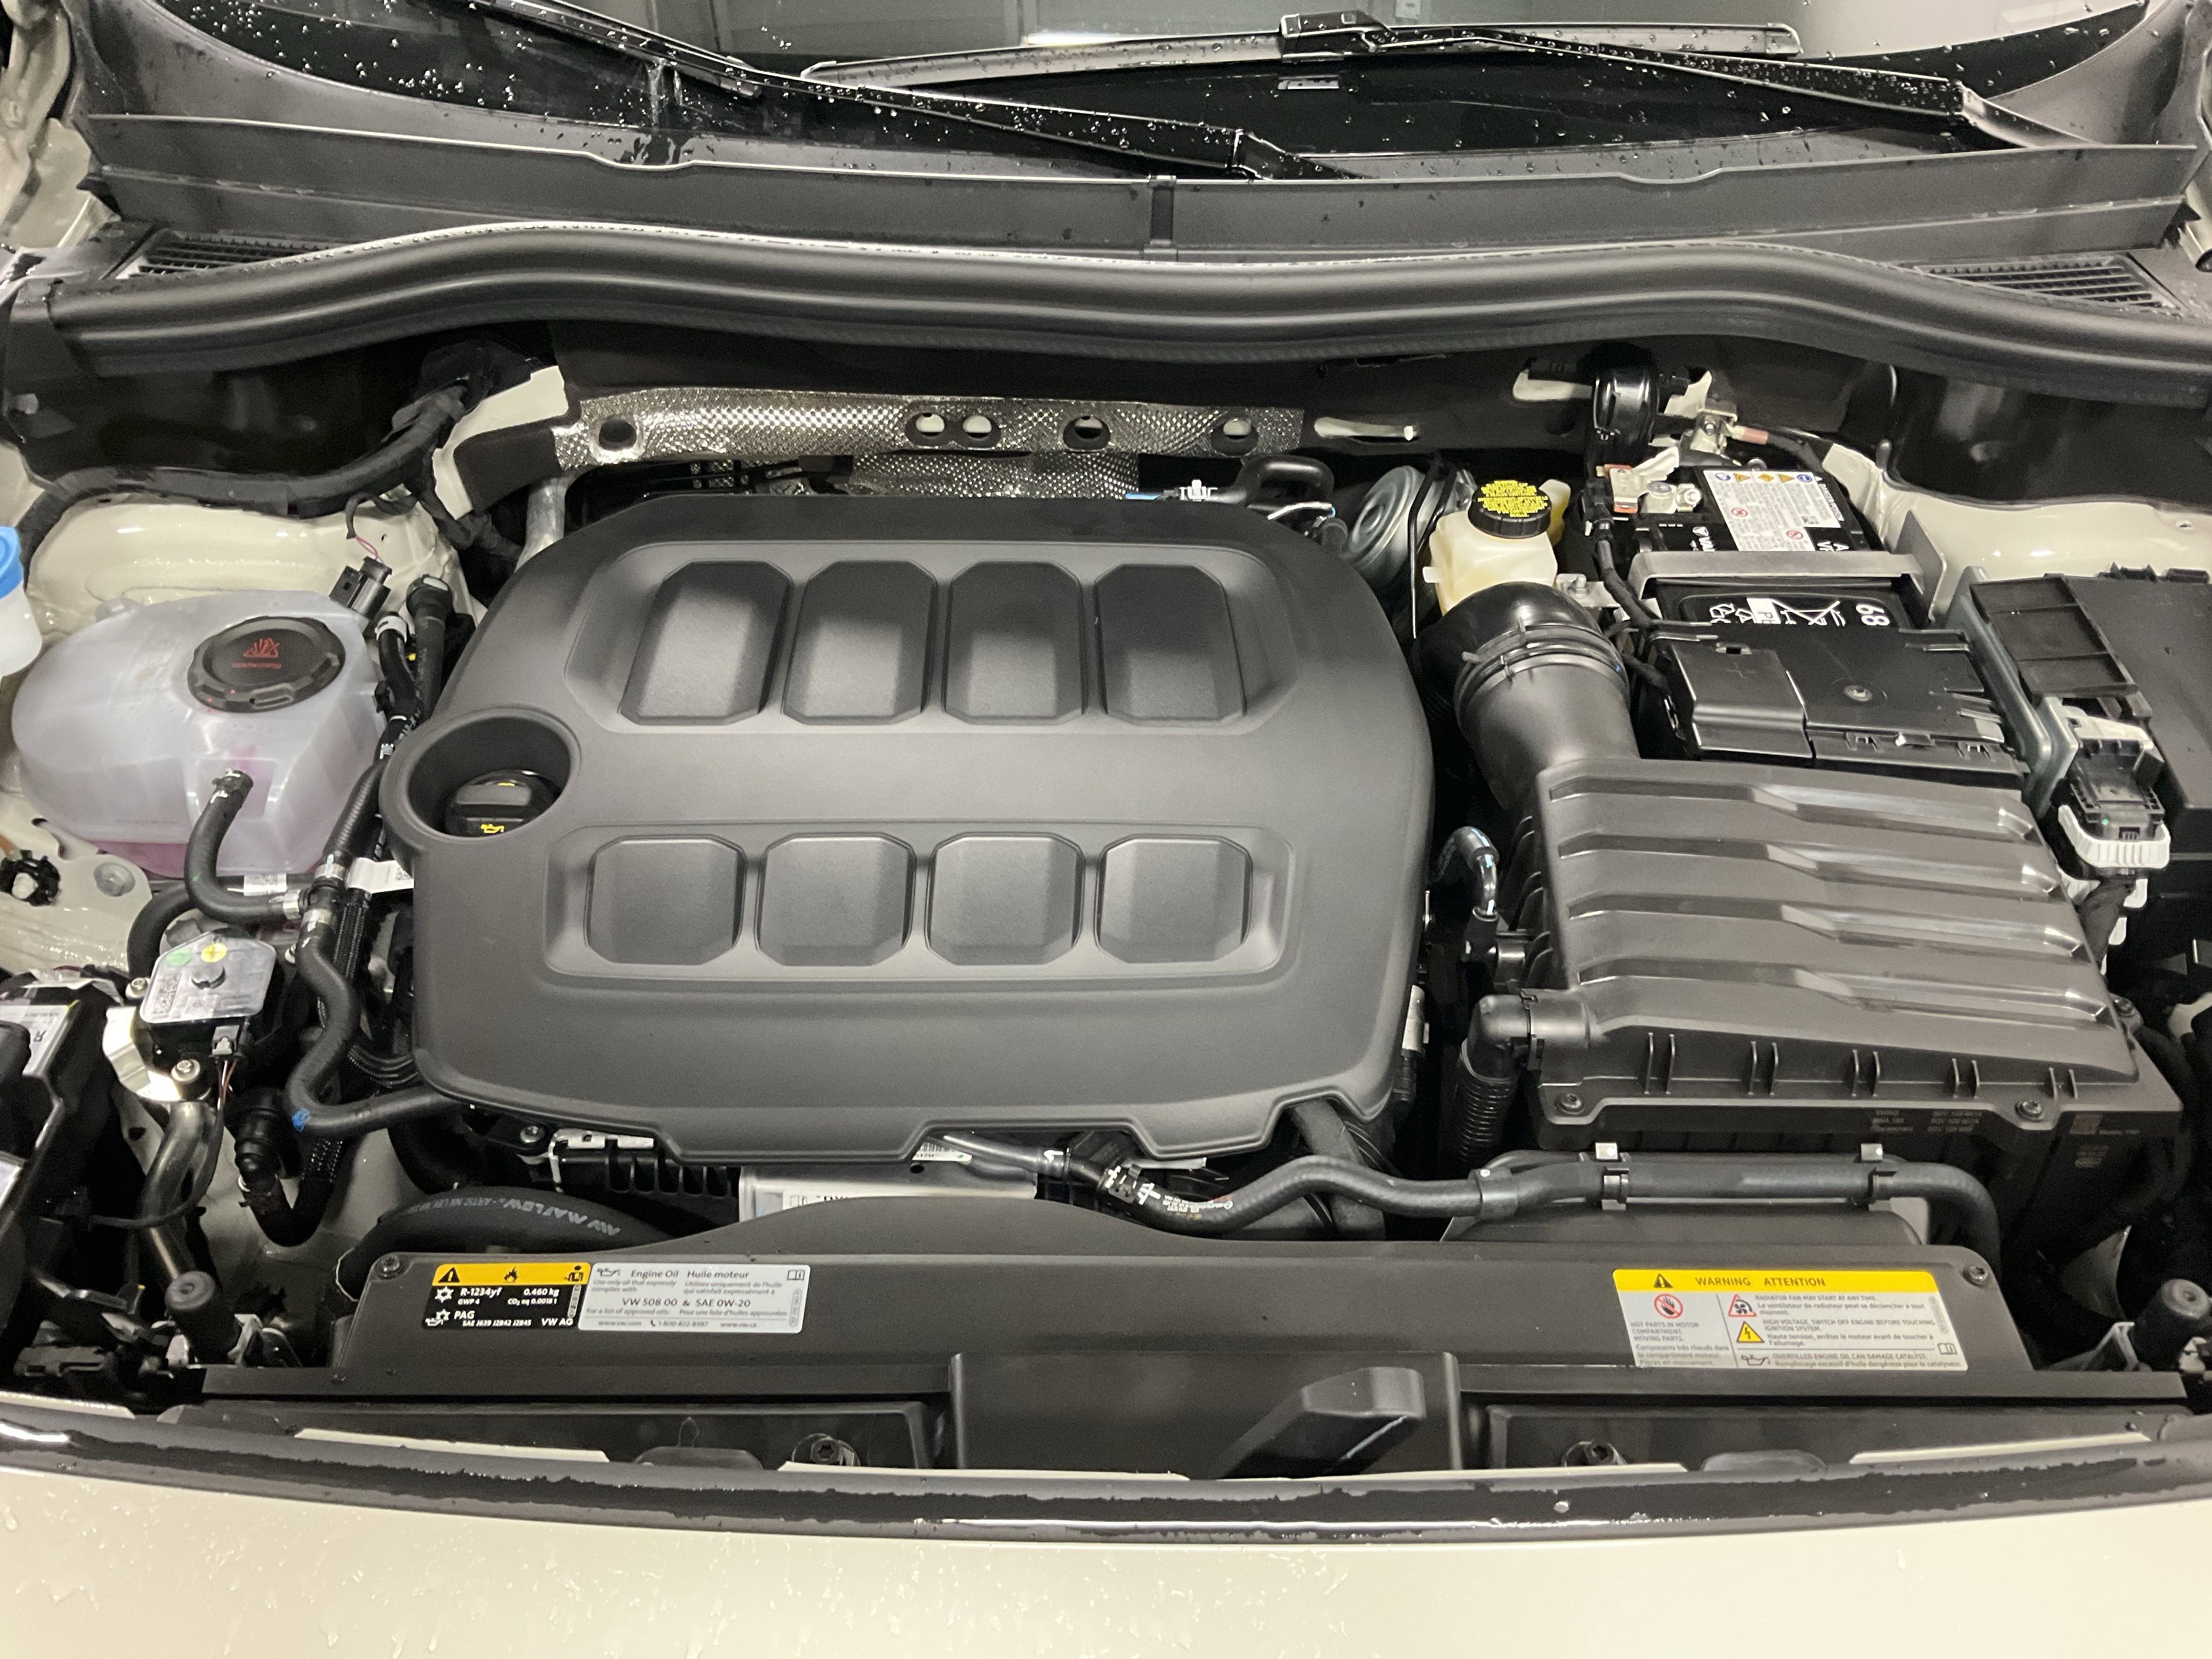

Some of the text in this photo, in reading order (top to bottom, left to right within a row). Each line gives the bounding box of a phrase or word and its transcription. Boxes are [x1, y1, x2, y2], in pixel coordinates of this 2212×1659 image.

[1856, 603, 1890, 626] 68
[631, 1269, 663, 1279] Engine
[1696, 1277, 1826, 1286] WARNING ATTENTION
[460, 1287, 502, 1298] R-1234yf
[549, 1288, 560, 1297] kg
[454, 1310, 475, 1319] PAG
[541, 1318, 558, 1326] VW
